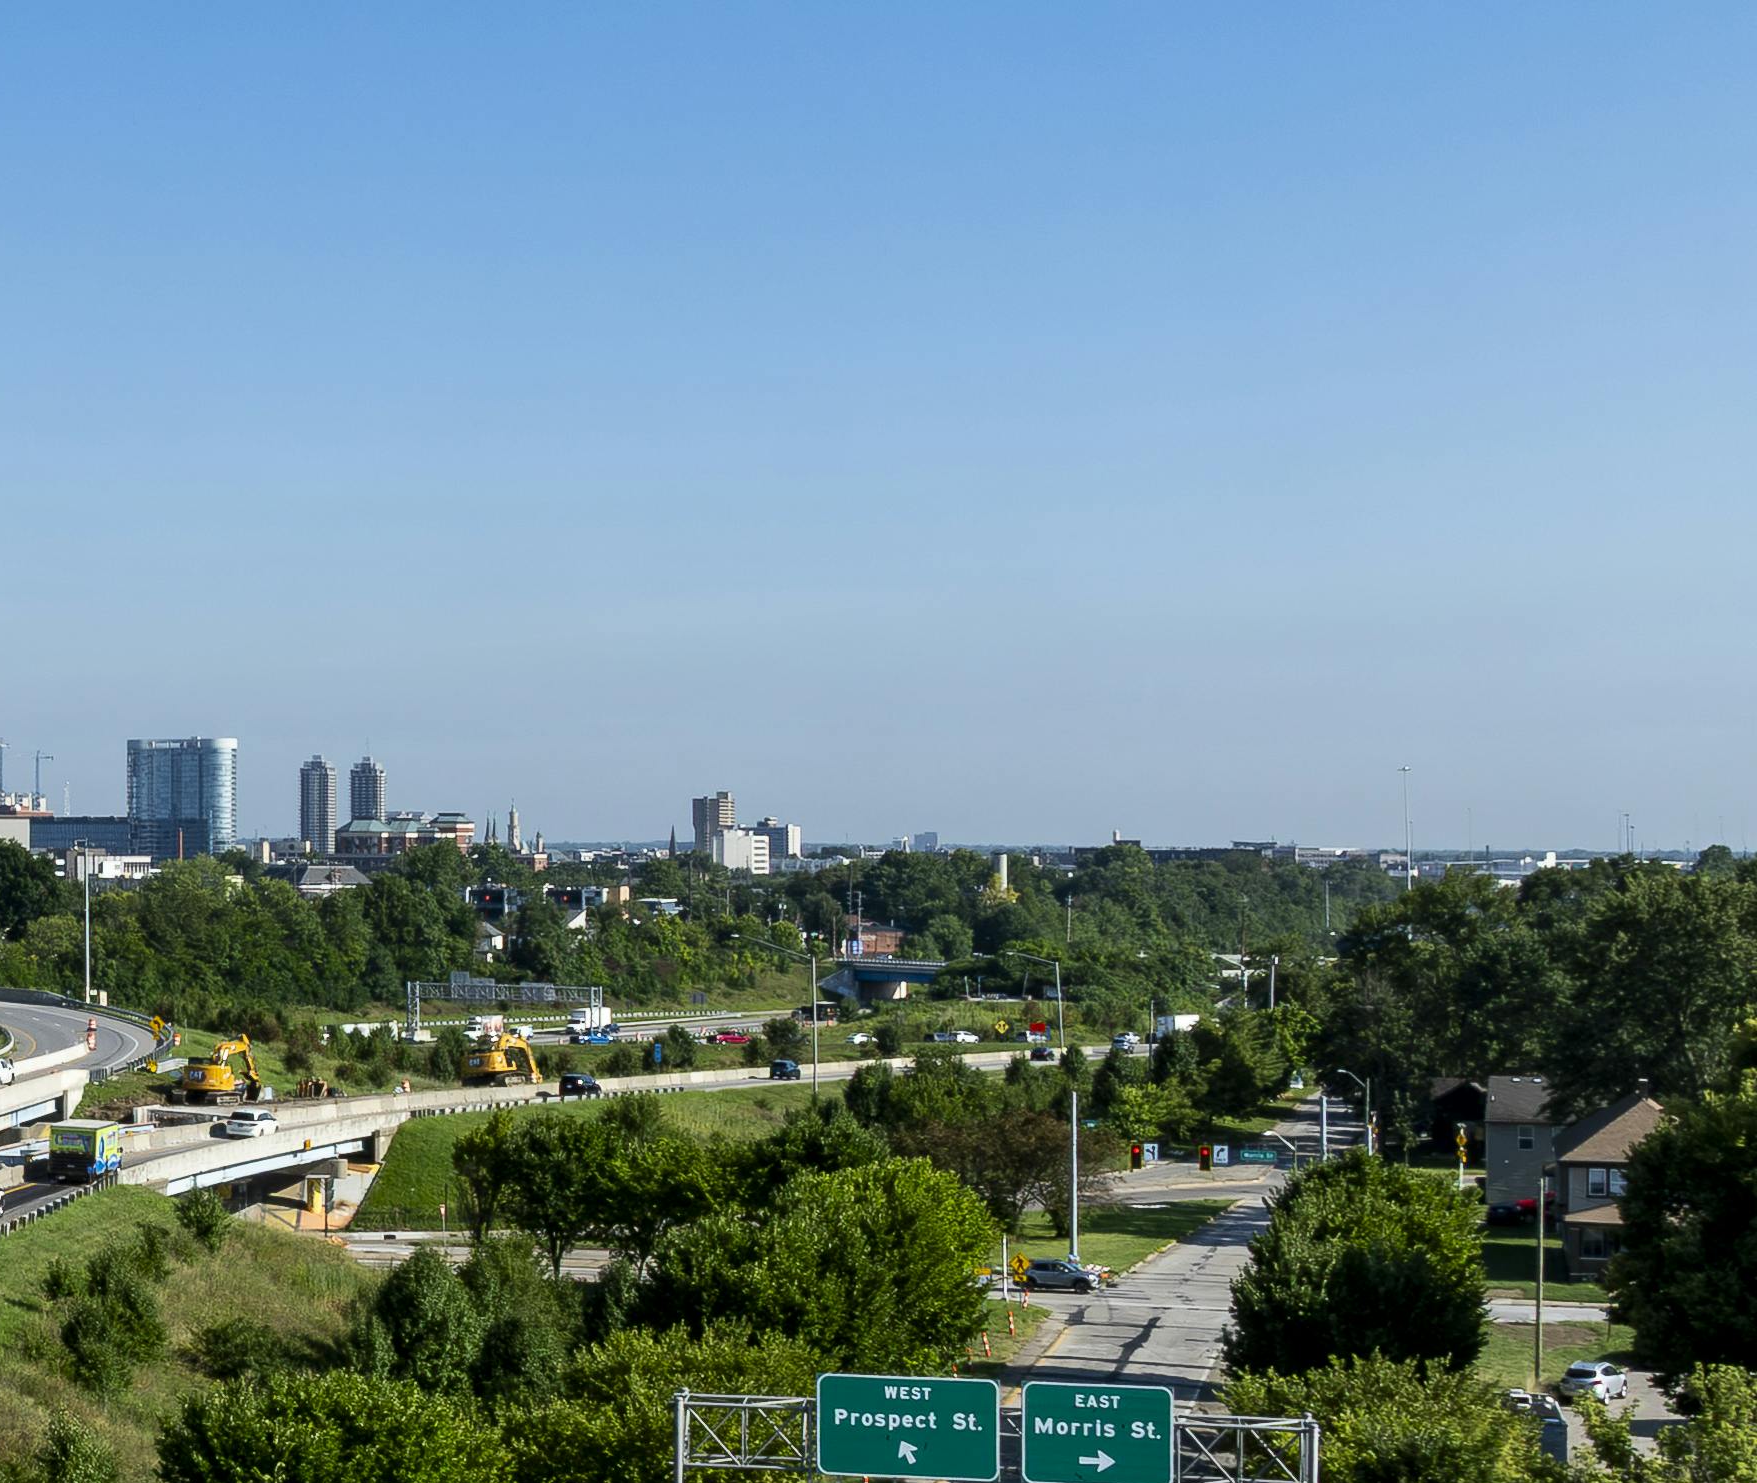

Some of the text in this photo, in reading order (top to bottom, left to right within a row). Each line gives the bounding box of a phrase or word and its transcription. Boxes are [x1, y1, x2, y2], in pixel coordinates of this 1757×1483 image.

[189, 1071, 203, 1080] CAT
[884, 1385, 932, 1401] WEST
[1074, 1394, 1121, 1409] EAST
[834, 1408, 984, 1432] Prospect St.
[1034, 1417, 1162, 1440] Morris St.
